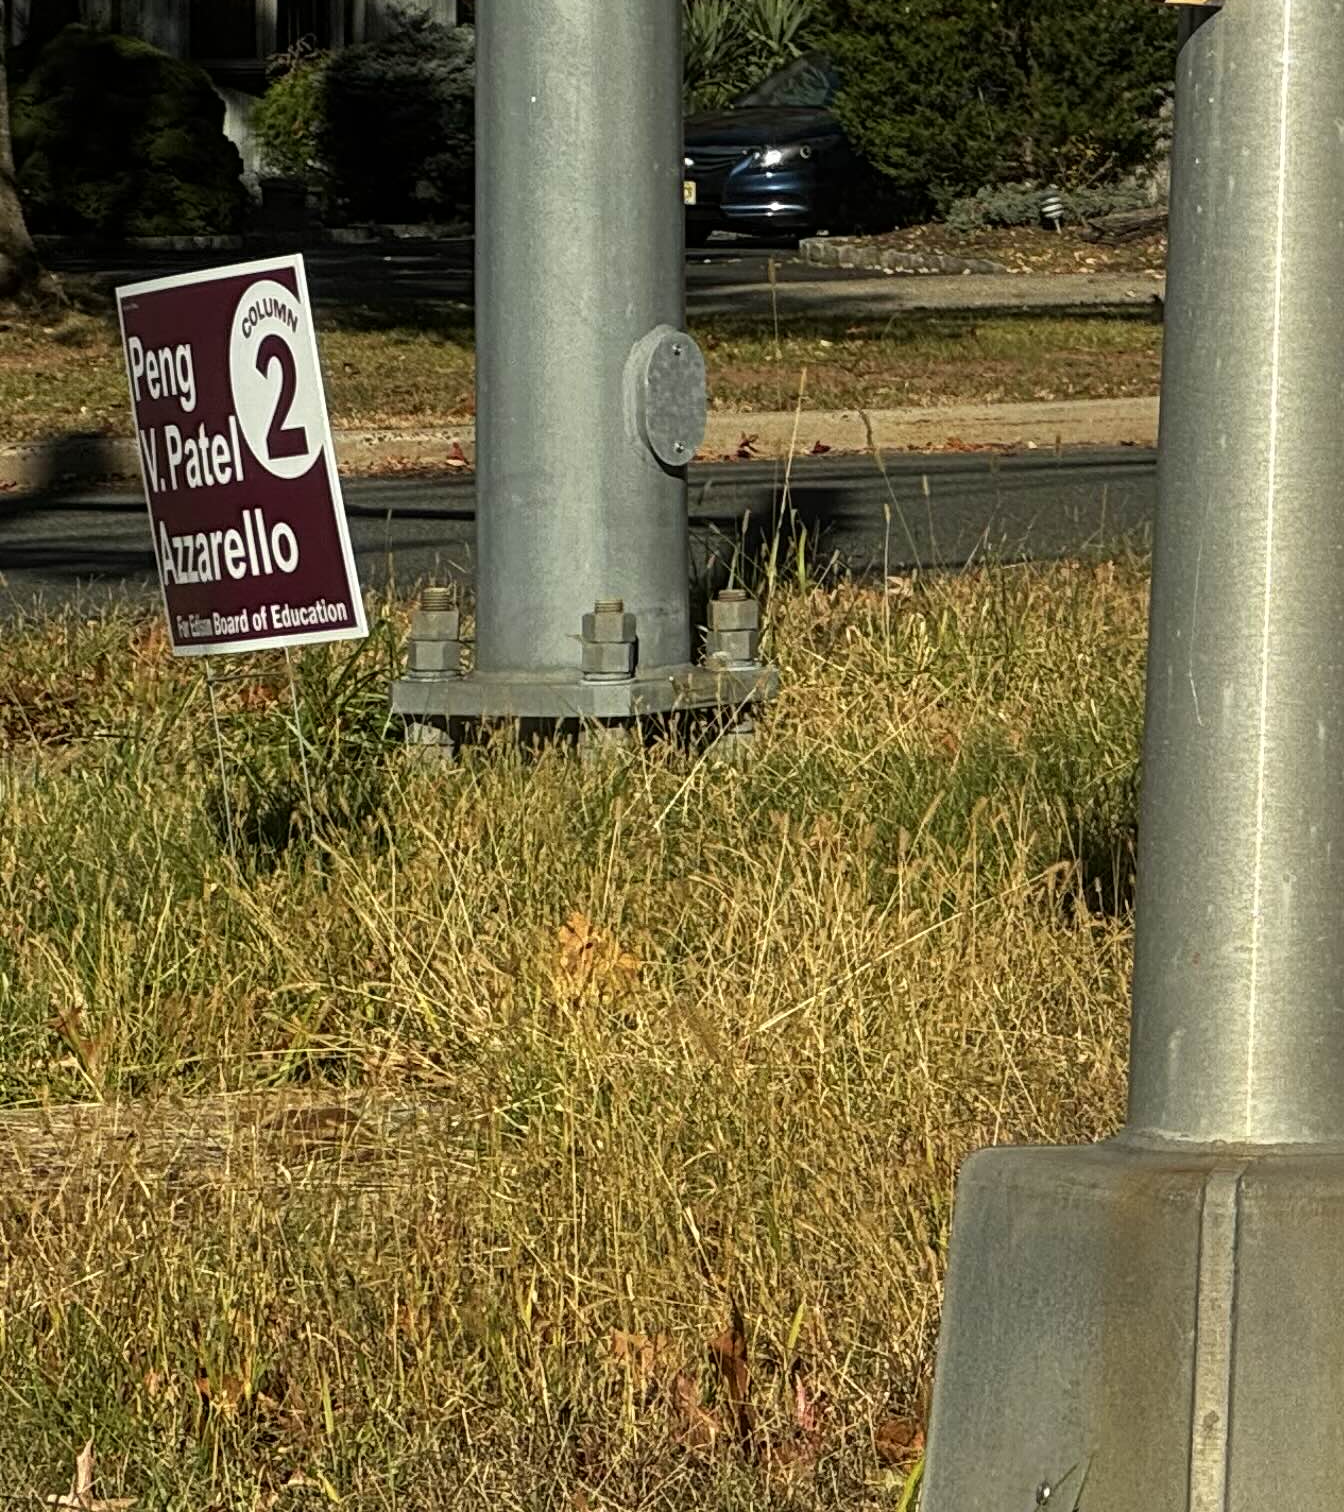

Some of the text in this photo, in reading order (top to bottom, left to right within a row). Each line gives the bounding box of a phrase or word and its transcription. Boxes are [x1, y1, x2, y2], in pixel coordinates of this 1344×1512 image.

[241, 297, 299, 340] COLUMN
[127, 336, 197, 413] Peng
[255, 334, 310, 460] 2
[140, 415, 245, 493] V. Patel
[158, 508, 299, 586] Azzarello
[212, 608, 250, 636] Board
[252, 606, 267, 632] of
[270, 598, 348, 629] Education
